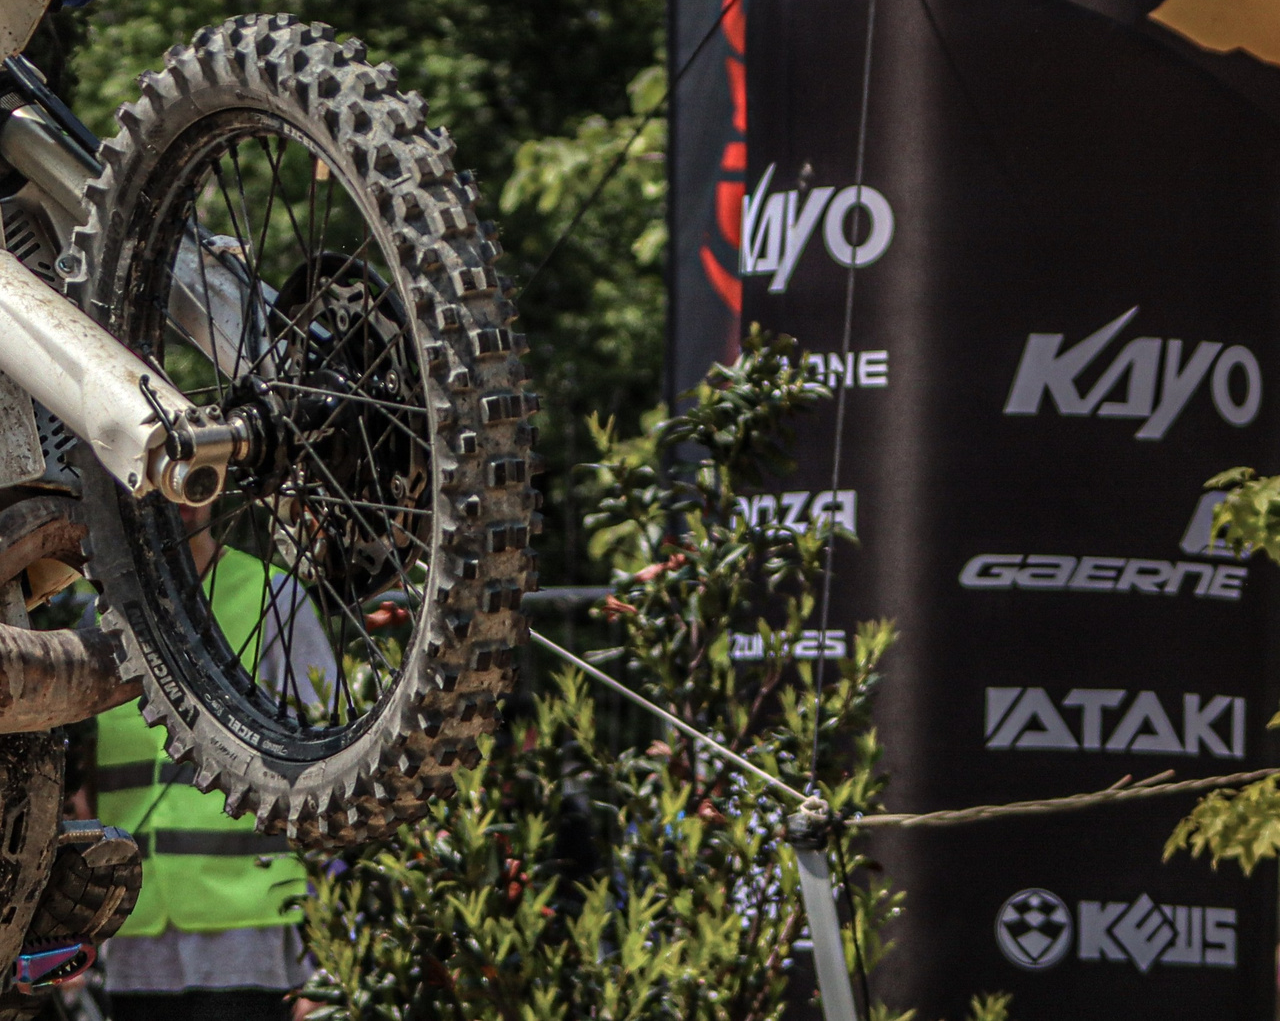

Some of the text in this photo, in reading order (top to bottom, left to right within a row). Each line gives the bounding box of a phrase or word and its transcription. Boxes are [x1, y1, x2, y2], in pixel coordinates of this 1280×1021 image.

[1003, 305, 1263, 441] KAYO
[130, 606, 183, 701] MICHELIN
[228, 714, 261, 746] EXCEL
[984, 687, 1246, 759] ATAKI
